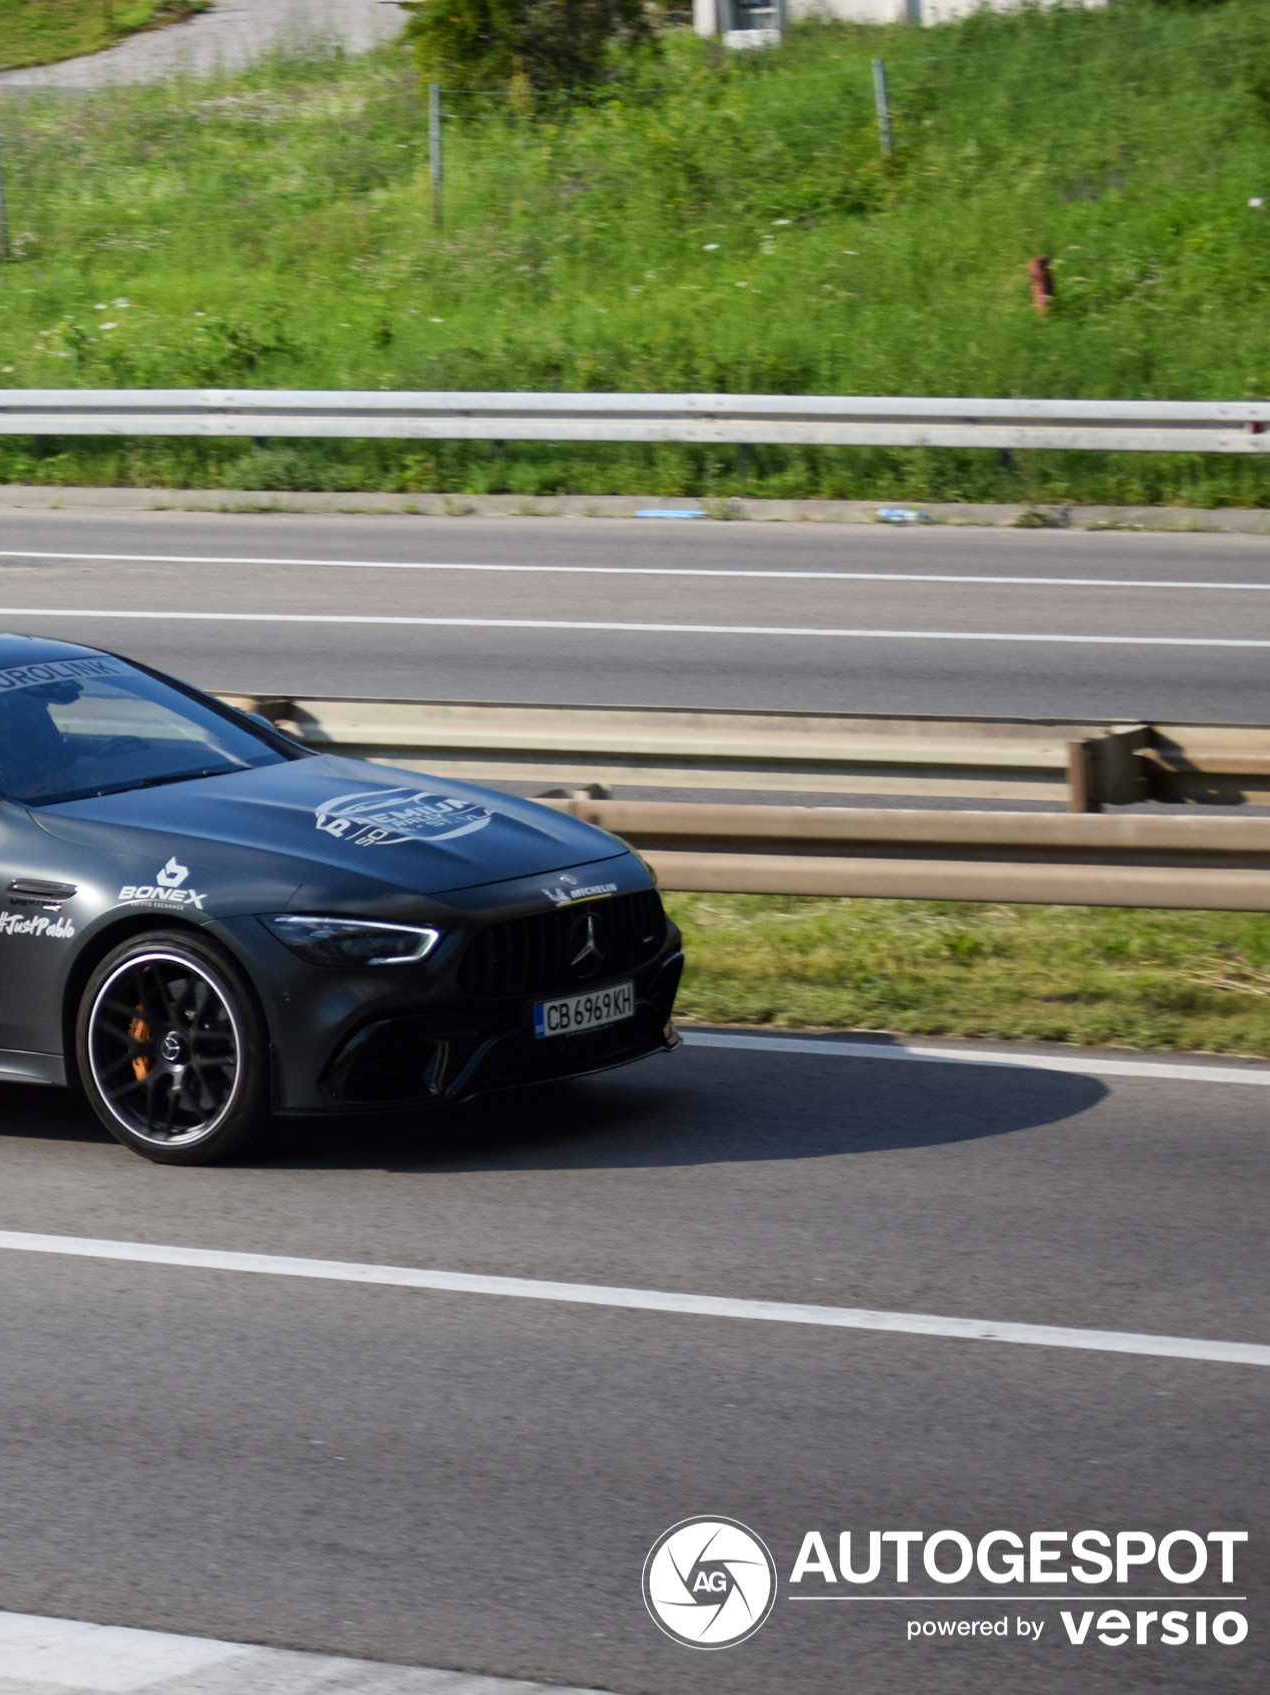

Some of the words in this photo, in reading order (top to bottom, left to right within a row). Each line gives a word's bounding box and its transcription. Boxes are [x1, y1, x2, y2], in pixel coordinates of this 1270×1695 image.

[117, 885, 208, 910] BONEX
[569, 883, 618, 899] MICHELIN
[153, 901, 185, 911] EXCHANGE
